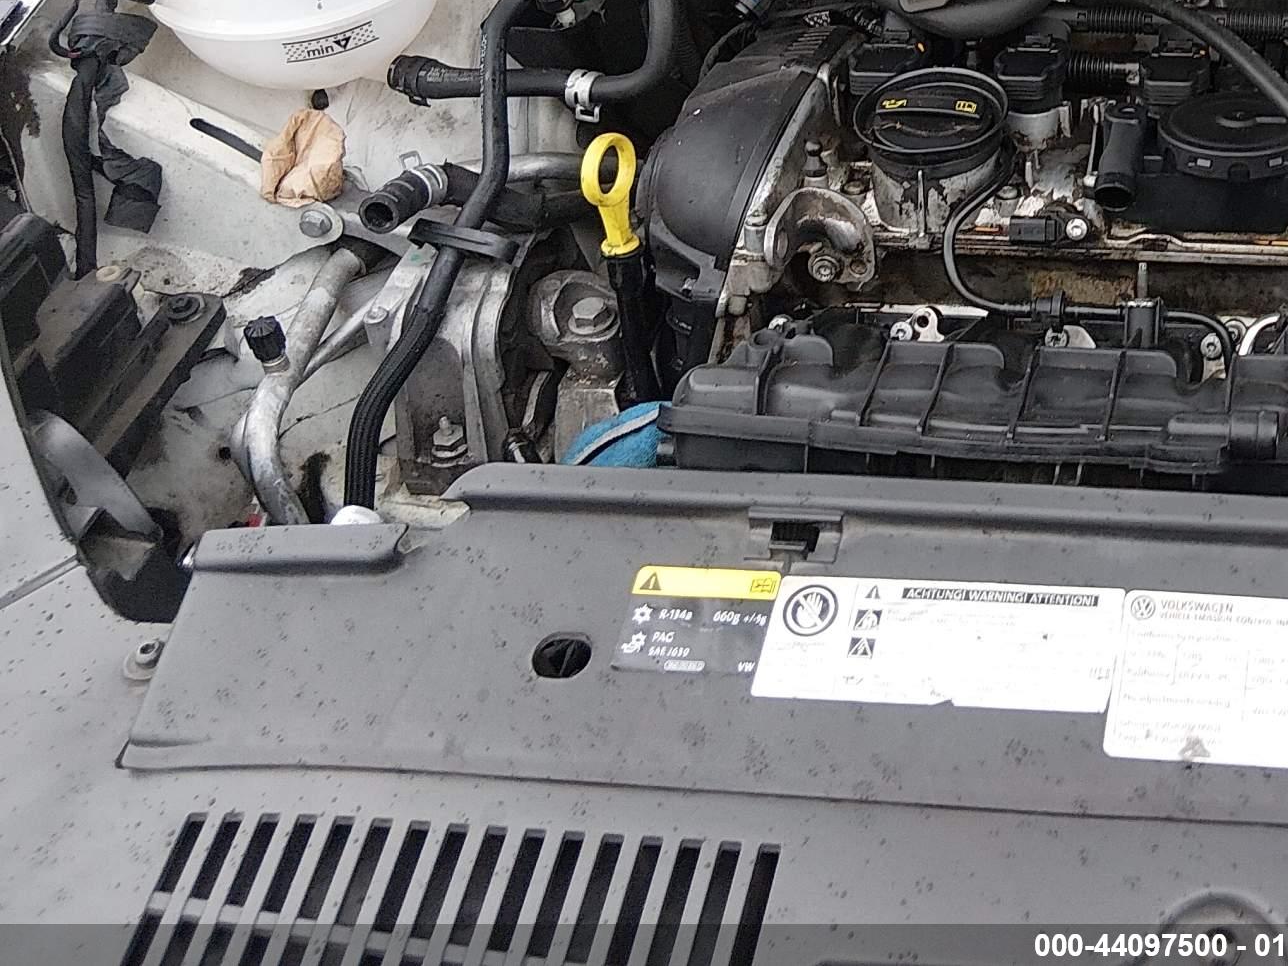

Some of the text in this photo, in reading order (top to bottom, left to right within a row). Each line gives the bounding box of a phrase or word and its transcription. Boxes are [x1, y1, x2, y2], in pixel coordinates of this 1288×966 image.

[306, 44, 334, 57] min
[905, 588, 1096, 607] ACHTUNG! WARNING! ATTENTION!
[1161, 599, 1234, 613] VOLKSWAGEN
[712, 610, 741, 626] 660g
[651, 631, 675, 643] PAG
[738, 661, 756, 673] VW
